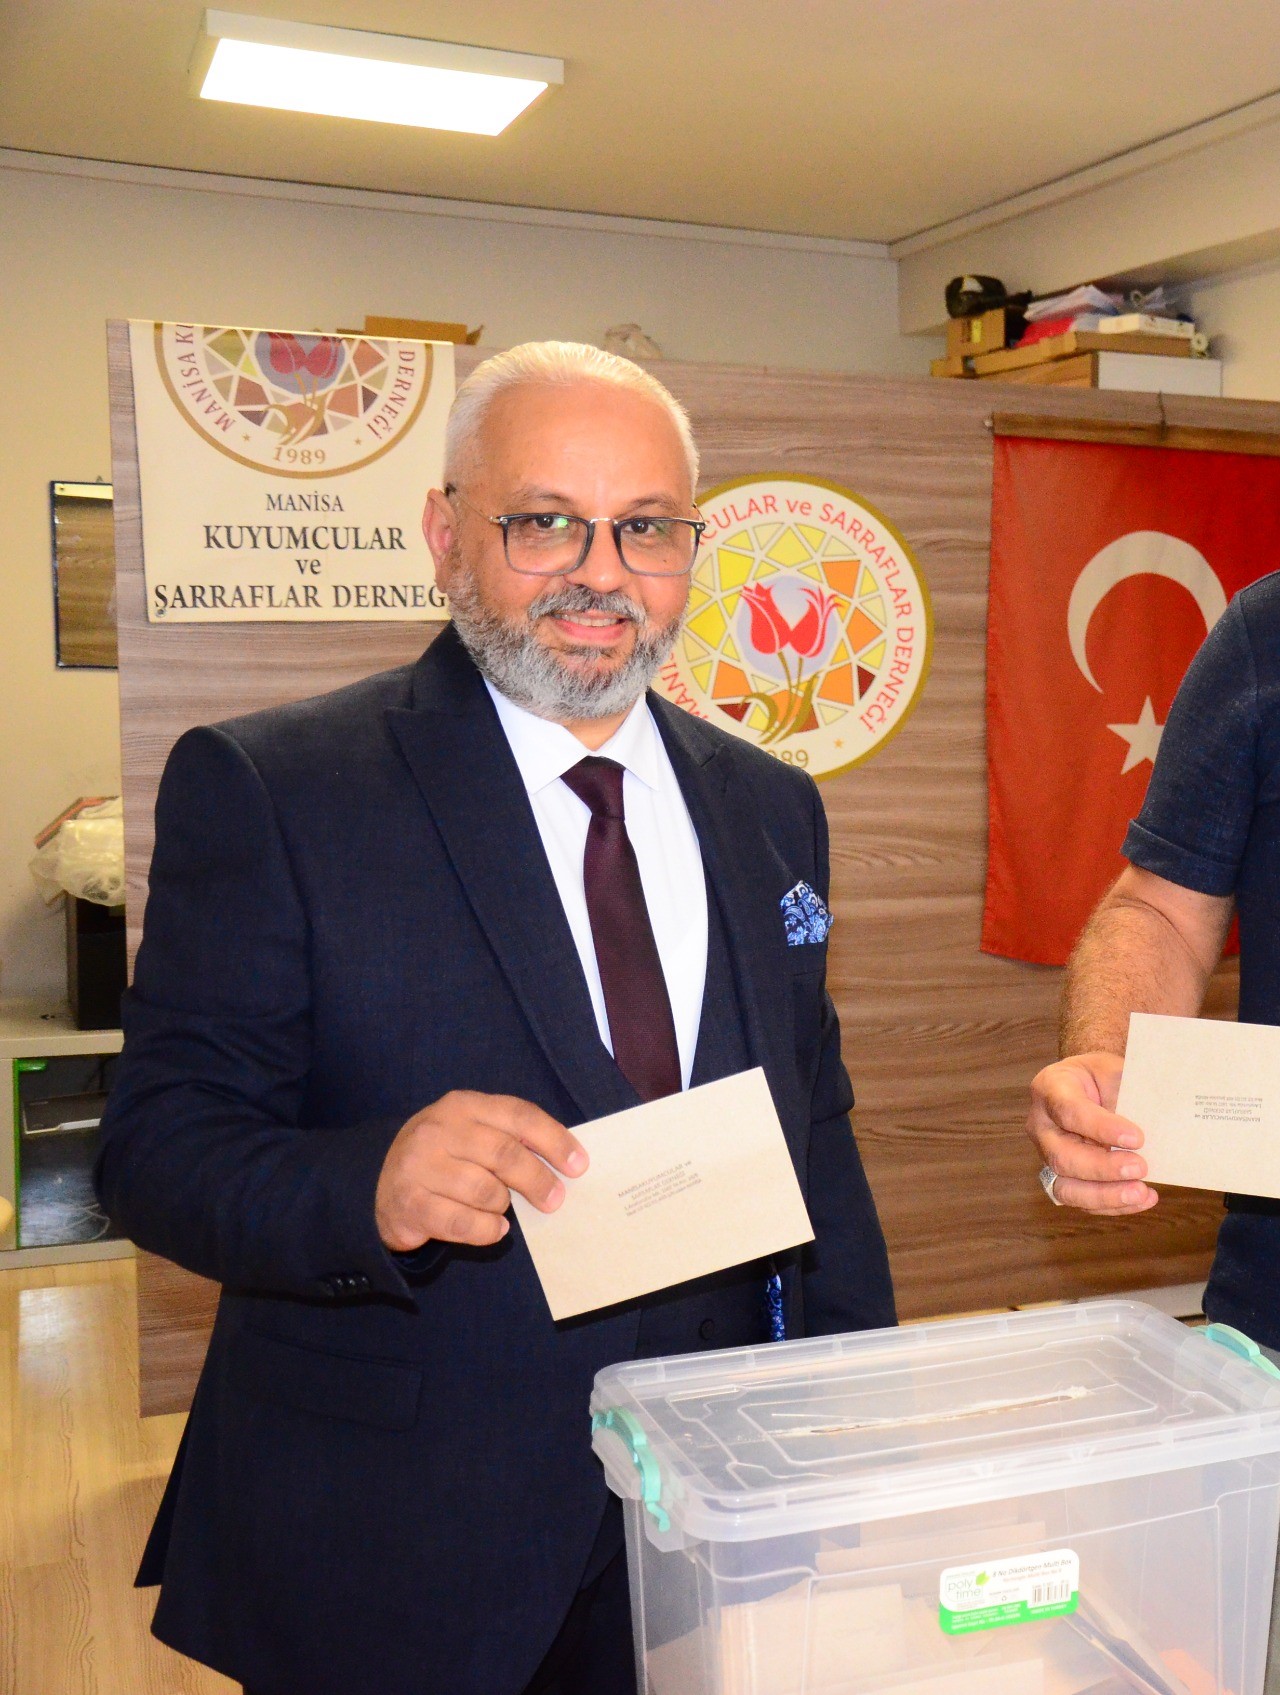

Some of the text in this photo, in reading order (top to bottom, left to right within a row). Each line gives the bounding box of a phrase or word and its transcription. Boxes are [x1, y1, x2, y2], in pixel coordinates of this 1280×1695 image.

[177, 353, 236, 432] MANİSA
[367, 350, 415, 439] DERNEĞİ
[273, 446, 326, 465] 1989
[265, 490, 344, 512] MANİSA
[785, 499, 812, 516] ve
[203, 525, 407, 551] KUYUMCULAR
[295, 558, 322, 575] ve
[819, 503, 913, 619] SARRAFLAR
[860, 626, 914, 733] DERNEĞİ
[948, 1578, 973, 1592] poly
[956, 1588, 981, 1600] time
